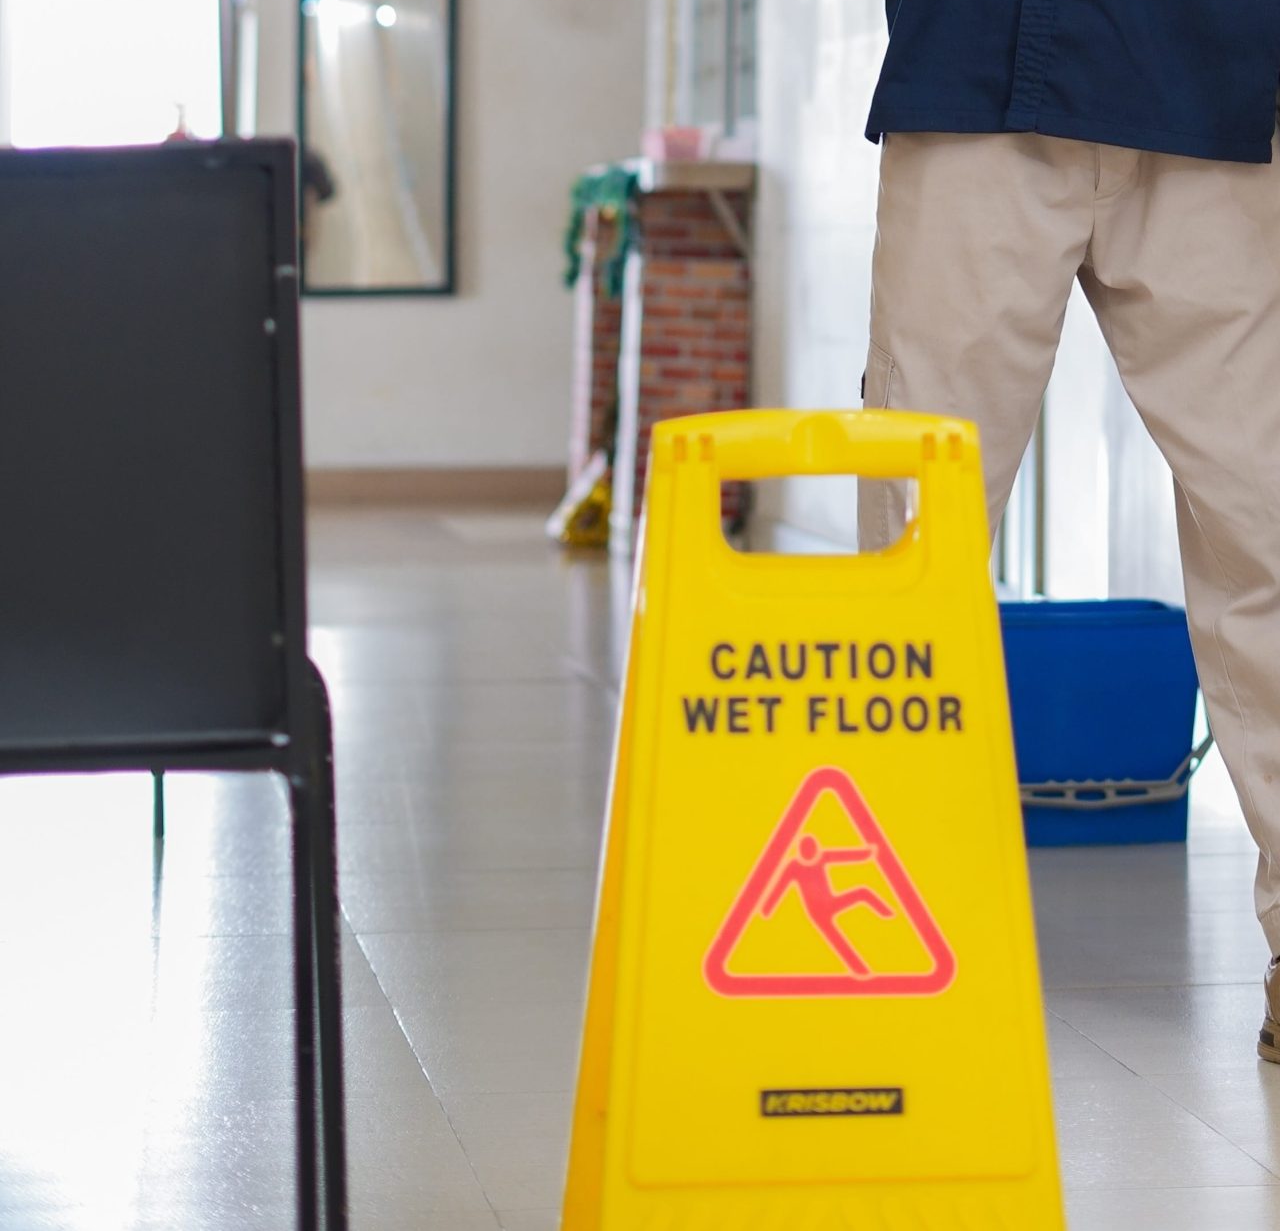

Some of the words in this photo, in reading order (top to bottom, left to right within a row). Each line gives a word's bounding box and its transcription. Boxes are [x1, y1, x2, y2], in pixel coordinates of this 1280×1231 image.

[710, 642, 933, 680] CAUTION
[682, 696, 782, 733] WET
[808, 695, 963, 733] FLOOR
[765, 1091, 899, 1114] KRISBOW
